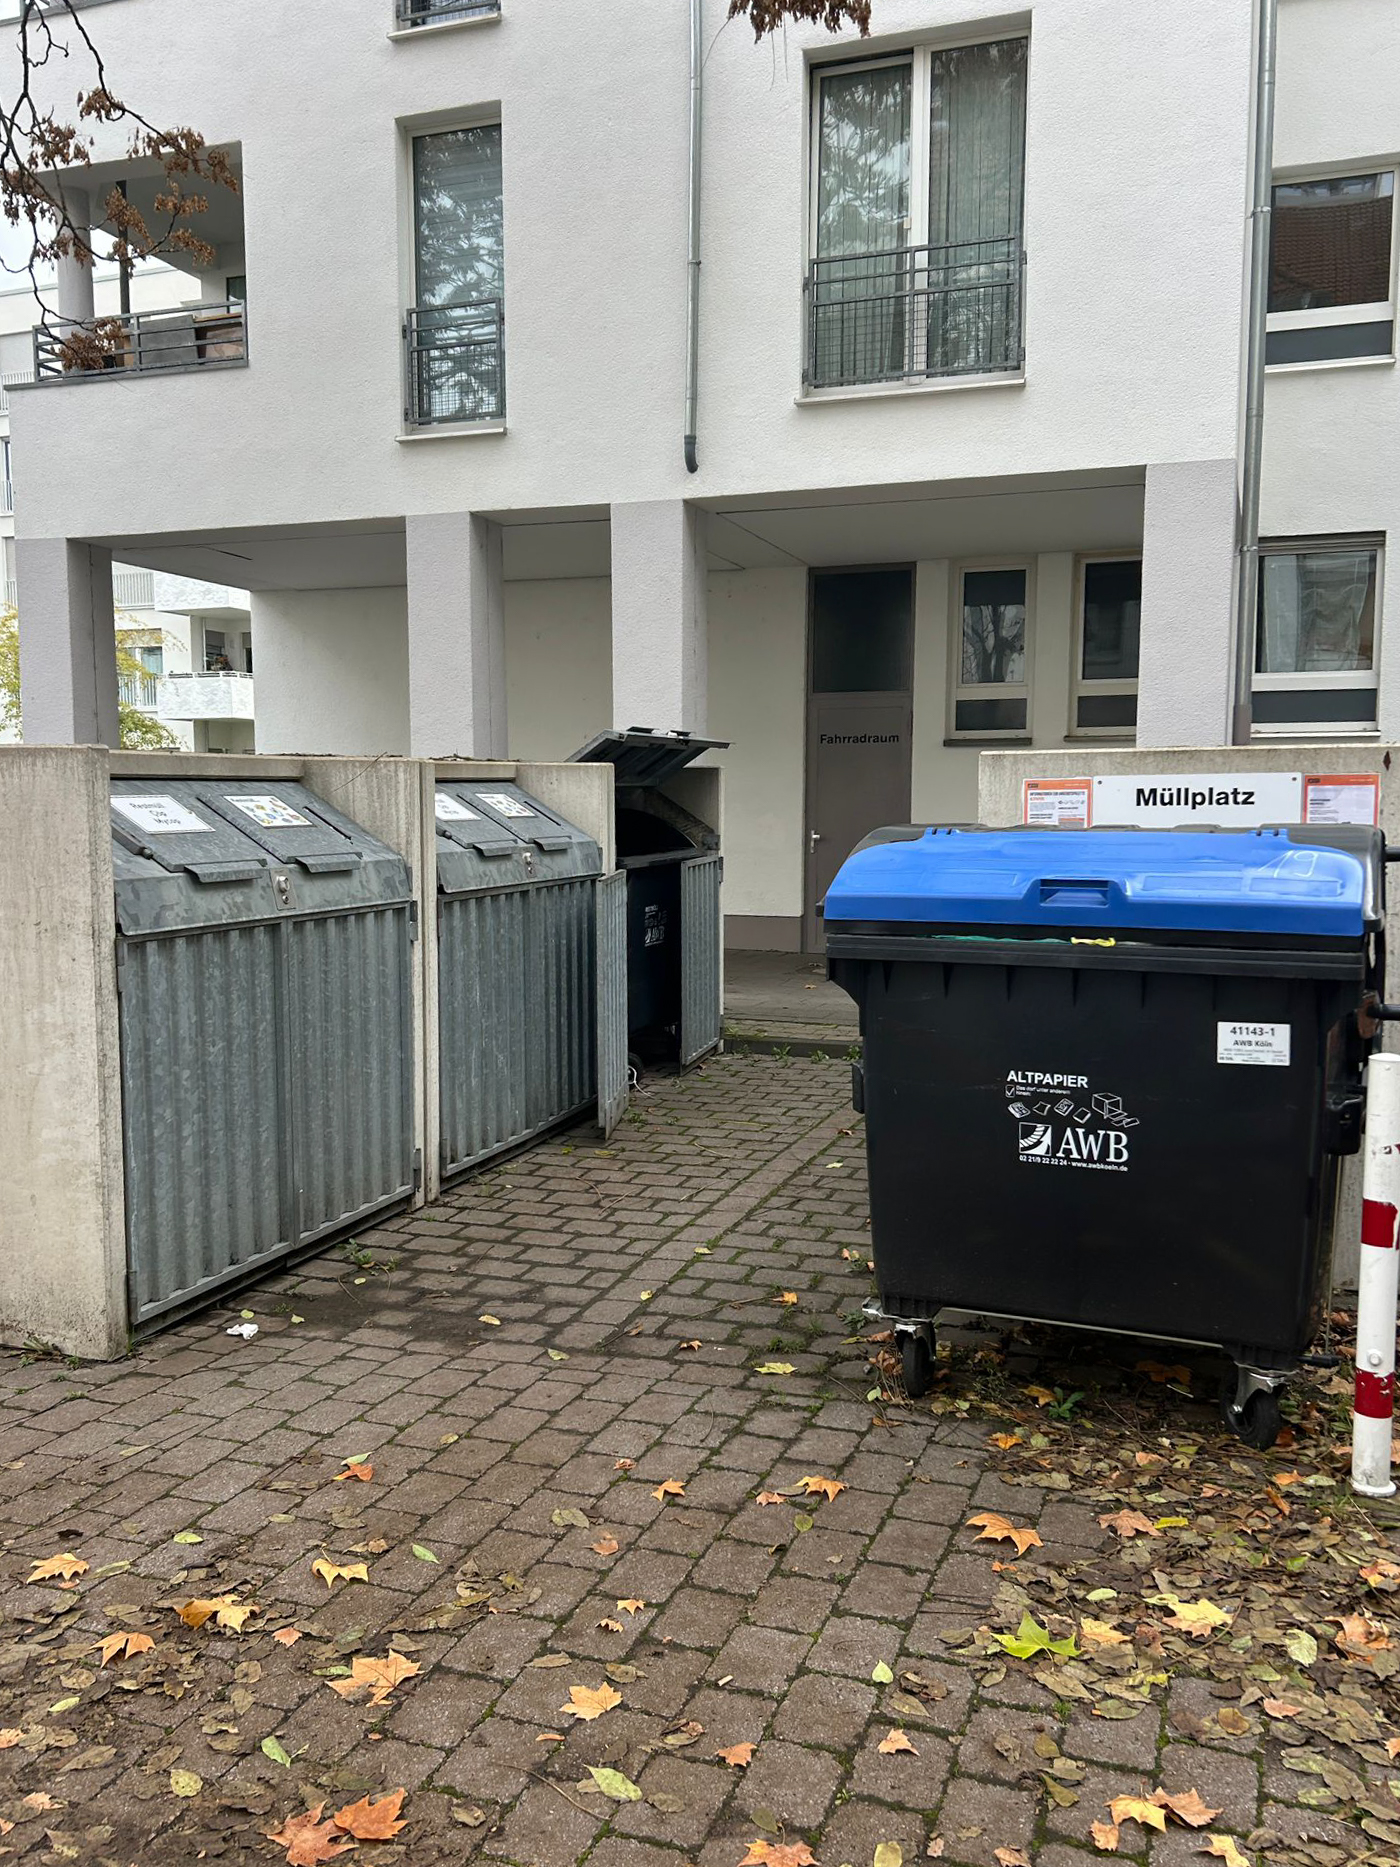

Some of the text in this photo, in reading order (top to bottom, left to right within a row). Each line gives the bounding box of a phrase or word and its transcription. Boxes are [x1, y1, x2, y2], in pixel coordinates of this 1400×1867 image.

[820, 734, 899, 744] Fahrradraum
[1136, 787, 1255, 810] Müllplatz
[1230, 1027, 1275, 1036] 41143-1
[1006, 1070, 1089, 1088] ALTPAPIER
[1056, 1127, 1129, 1163] AWB
[1019, 1154, 1028, 1162] 02
[1028, 1155, 1041, 1163] 21/9
[1071, 1160, 1128, 1172] www.awbkoeln.de
